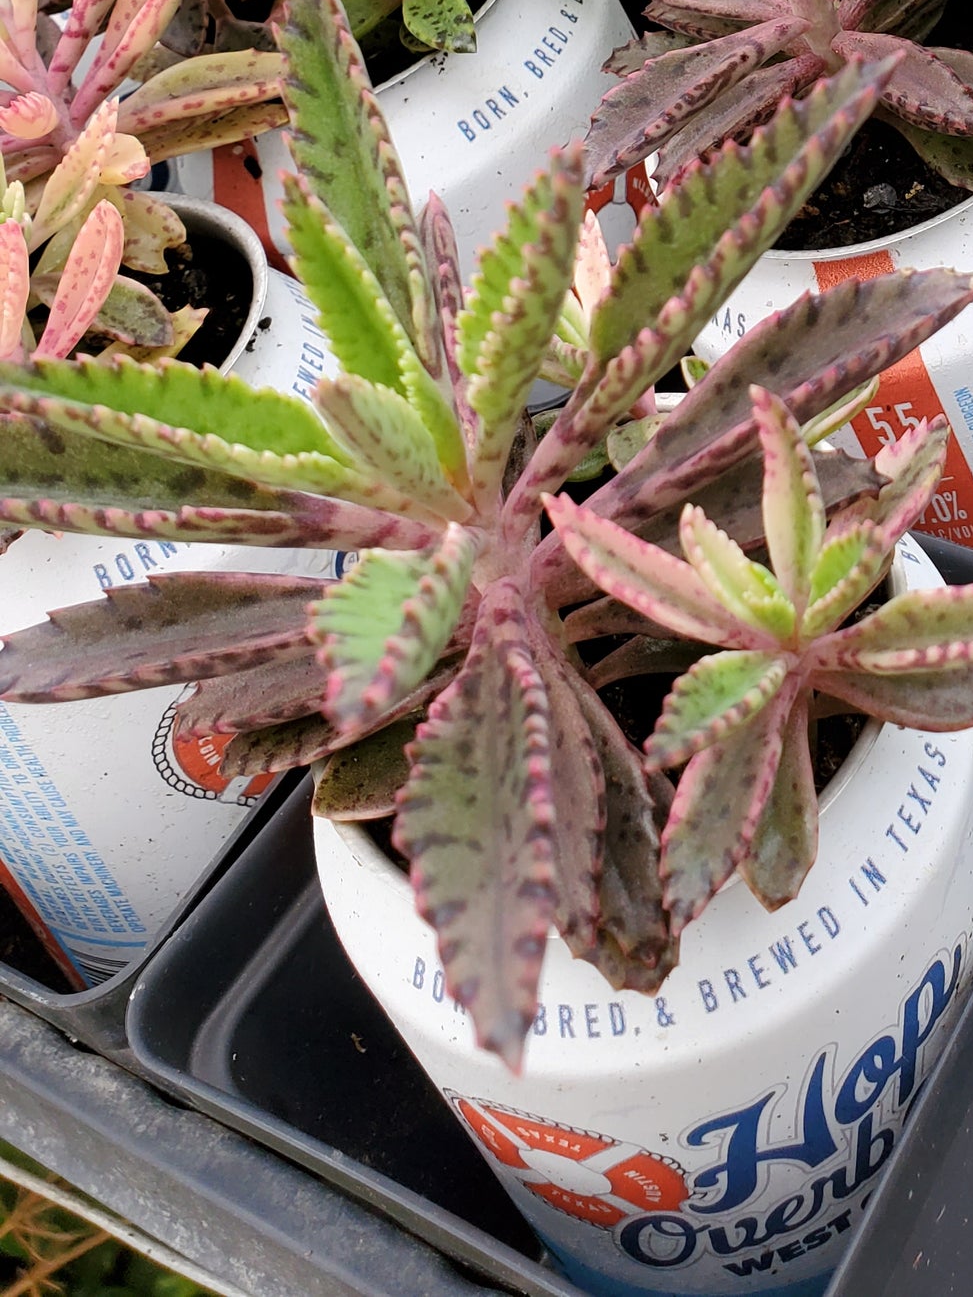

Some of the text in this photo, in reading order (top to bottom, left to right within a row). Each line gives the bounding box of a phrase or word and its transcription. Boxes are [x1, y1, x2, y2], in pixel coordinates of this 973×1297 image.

[457, 86, 528, 142] BORN,
[524, 27, 573, 79] BRED,
[560, 9, 578, 23] &
[292, 342, 325, 402] EWED
[198, 736, 222, 766] LGIN
[655, 997, 676, 1027] &
[698, 905, 842, 1014] BREWED
[848, 857, 887, 907] IN
[886, 741, 948, 855] TEXAS
[686, 945, 962, 1214] Hop
[721, 1209, 853, 1278] WEST
